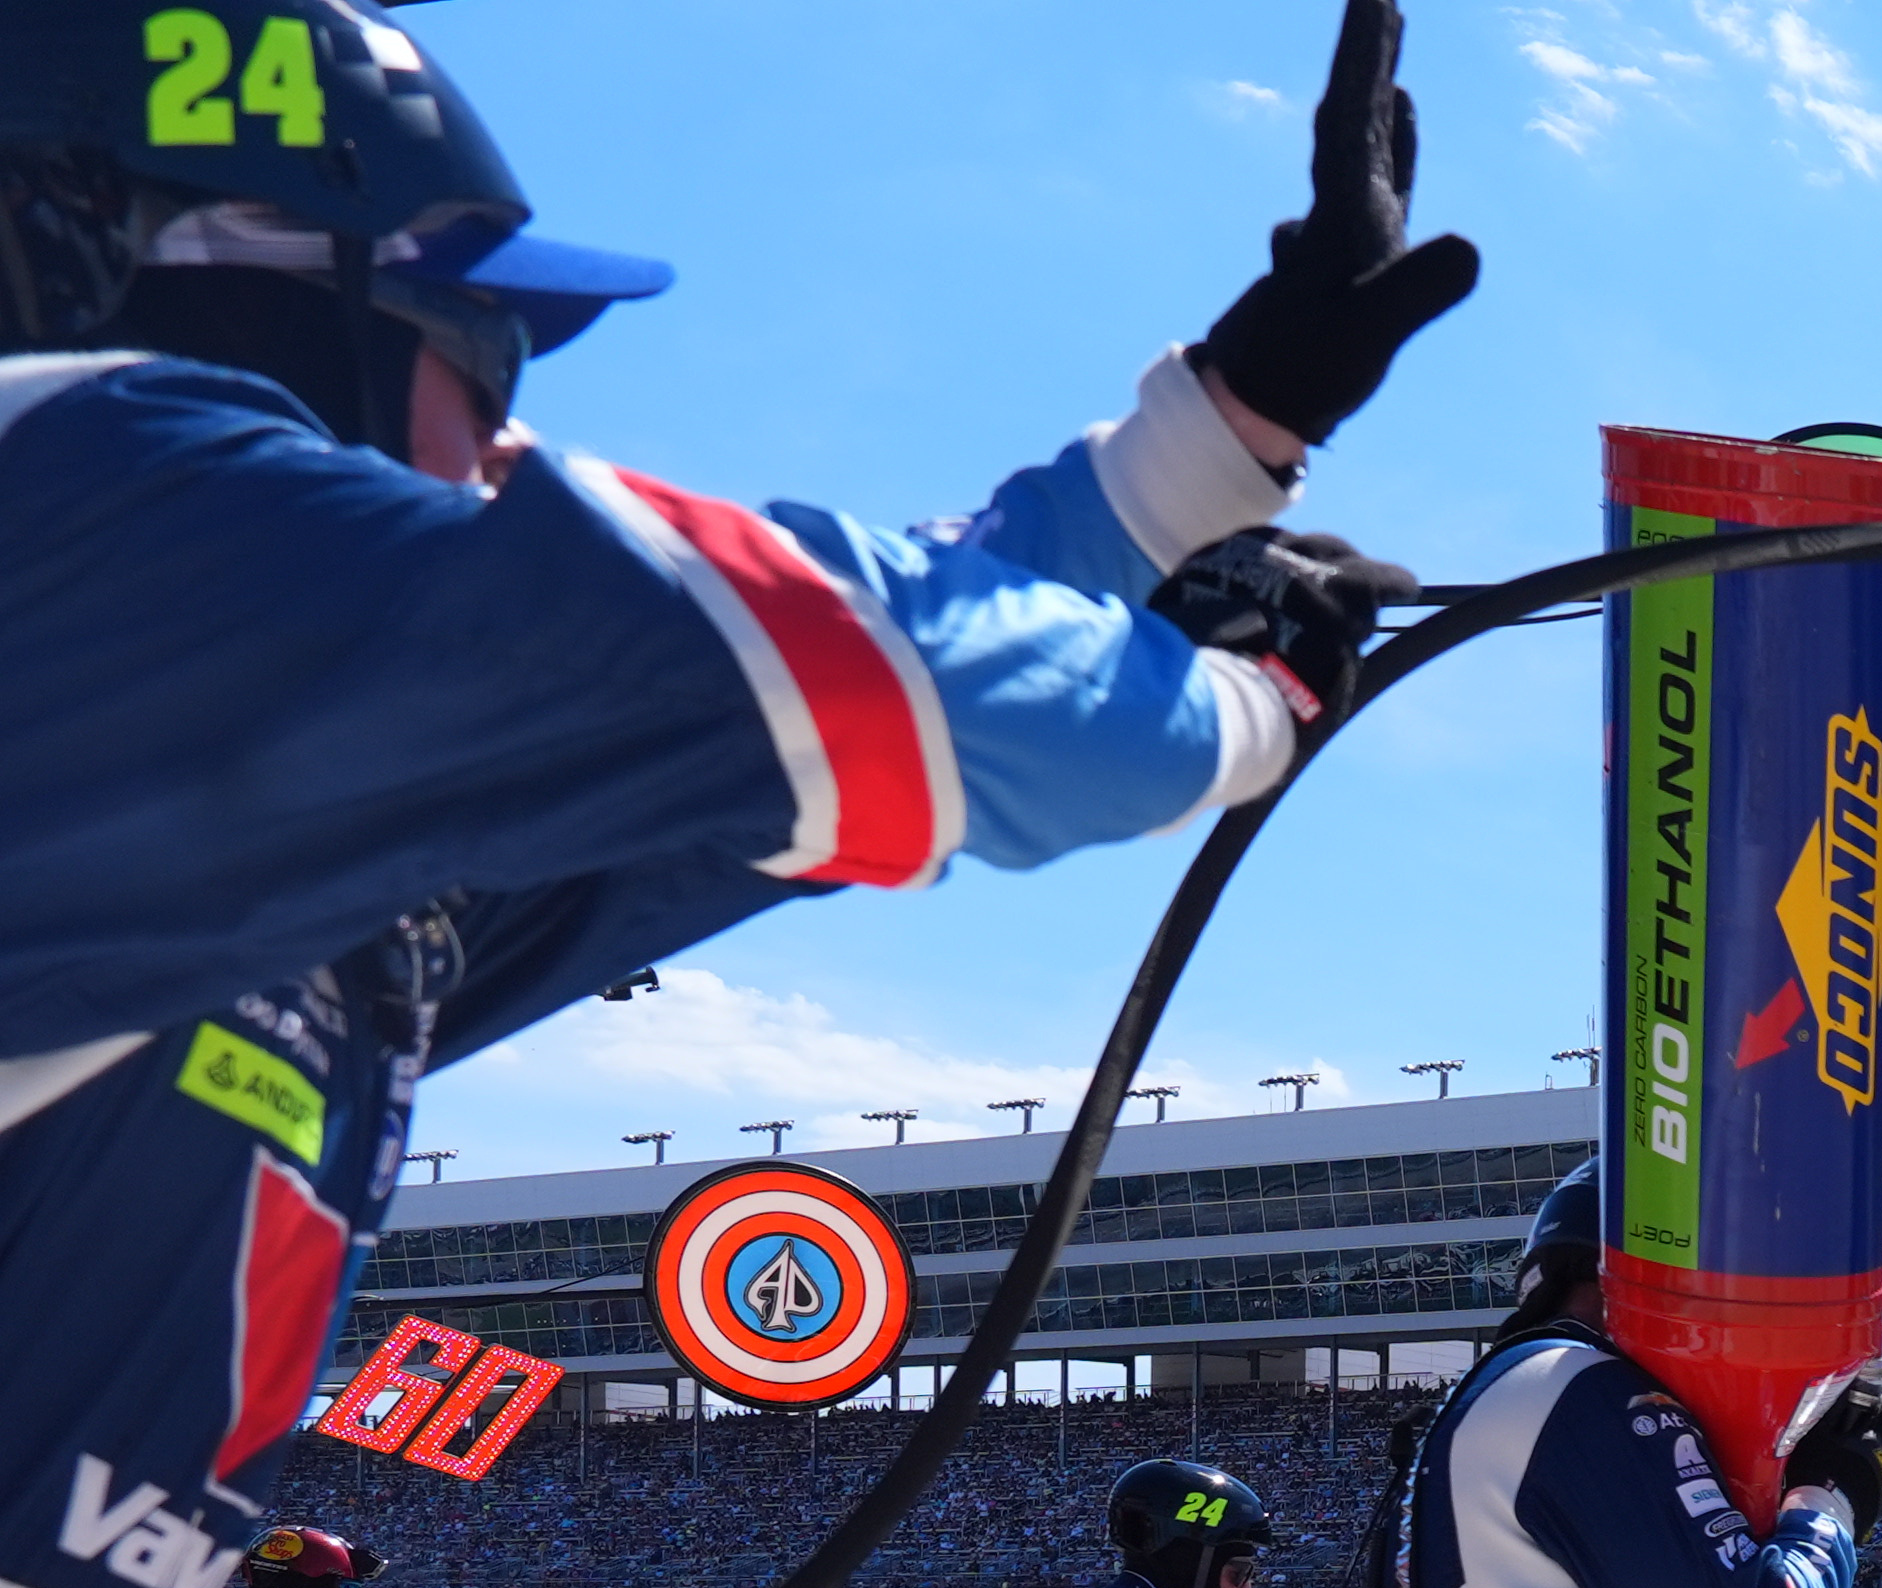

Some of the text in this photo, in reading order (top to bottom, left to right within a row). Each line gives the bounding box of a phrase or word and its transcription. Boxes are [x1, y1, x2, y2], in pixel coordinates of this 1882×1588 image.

[144, 9, 325, 147] 24
[1652, 630, 1698, 1165] BIOETHANOL
[1827, 729, 1882, 1101] SUNOCO
[1634, 955, 1649, 1148] ZERO CARBON
[1629, 1223, 1691, 1248] POET
[315, 1313, 565, 1481] 60
[1175, 1492, 1228, 1527] 24
